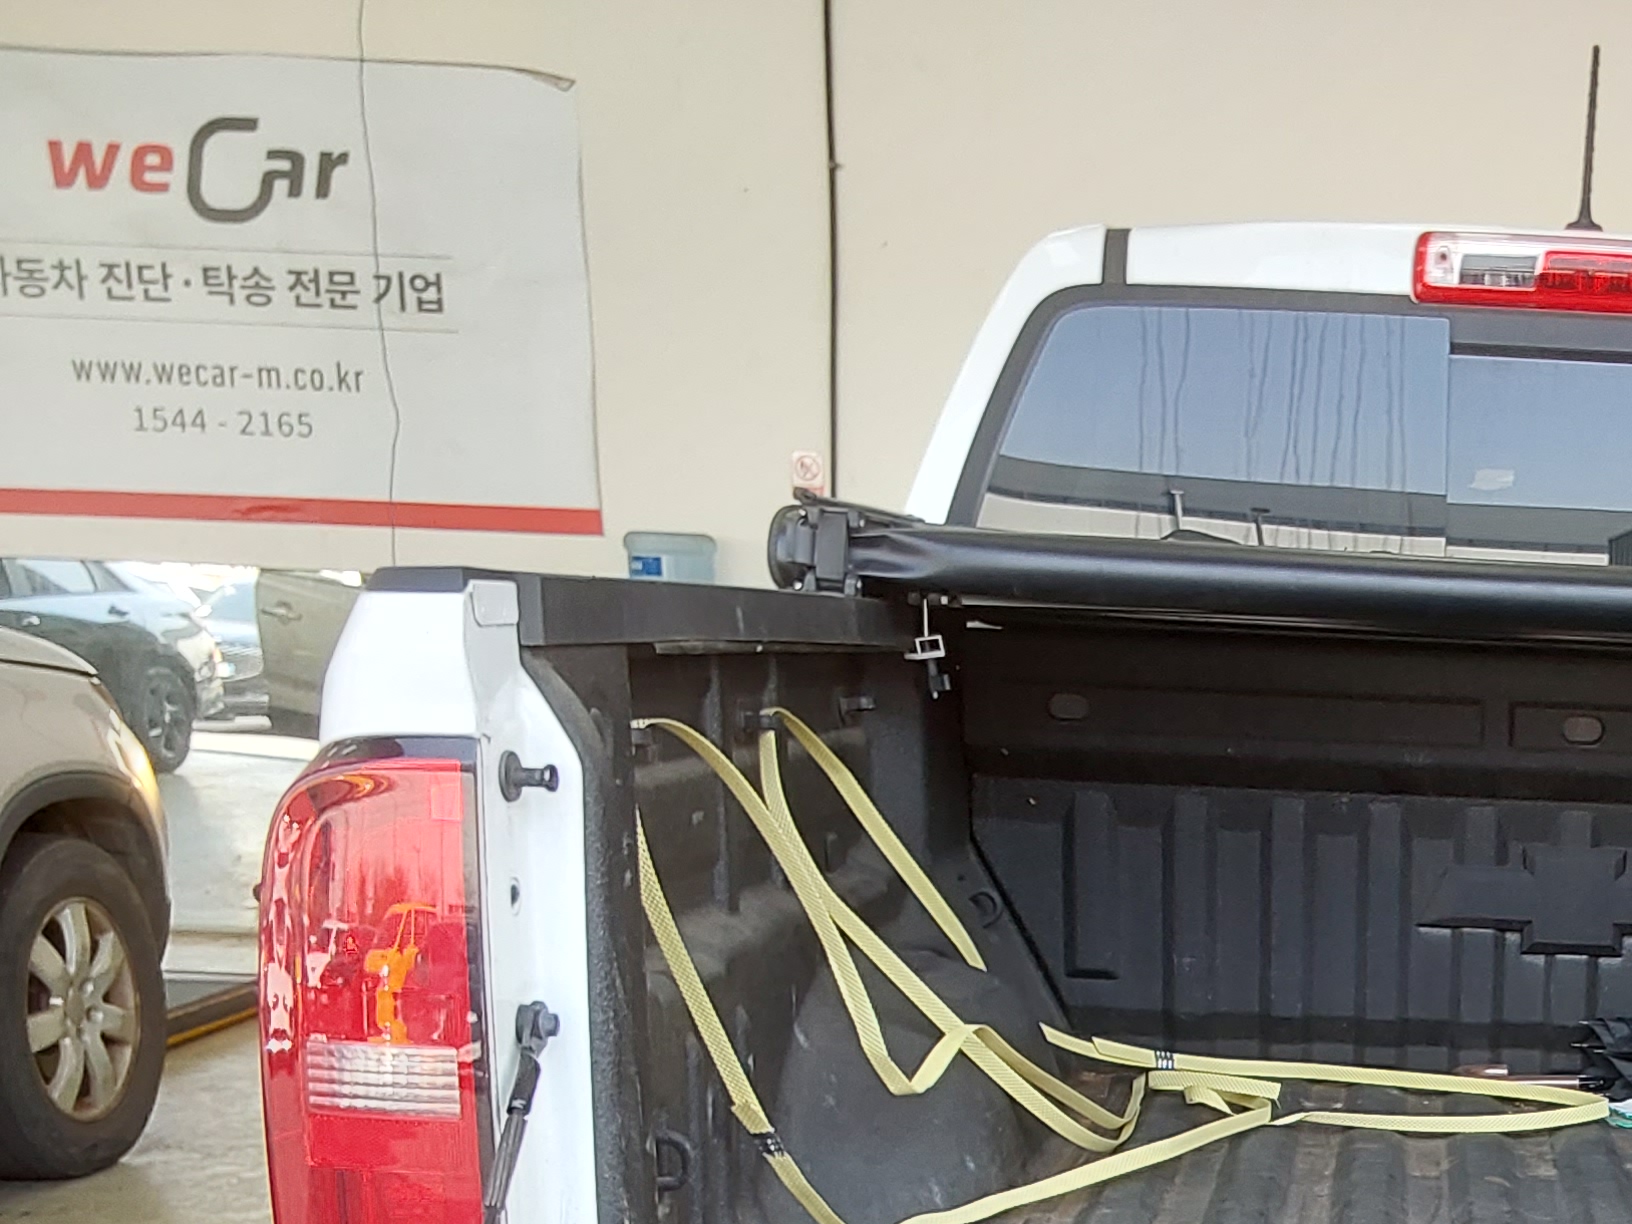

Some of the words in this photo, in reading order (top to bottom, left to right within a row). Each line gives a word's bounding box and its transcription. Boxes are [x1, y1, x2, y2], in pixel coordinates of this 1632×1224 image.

[47, 116, 349, 223] weCar
[287, 267, 361, 310] 전문
[372, 271, 445, 314] 기업
[71, 358, 365, 393] www.wecar-m.co.kr
